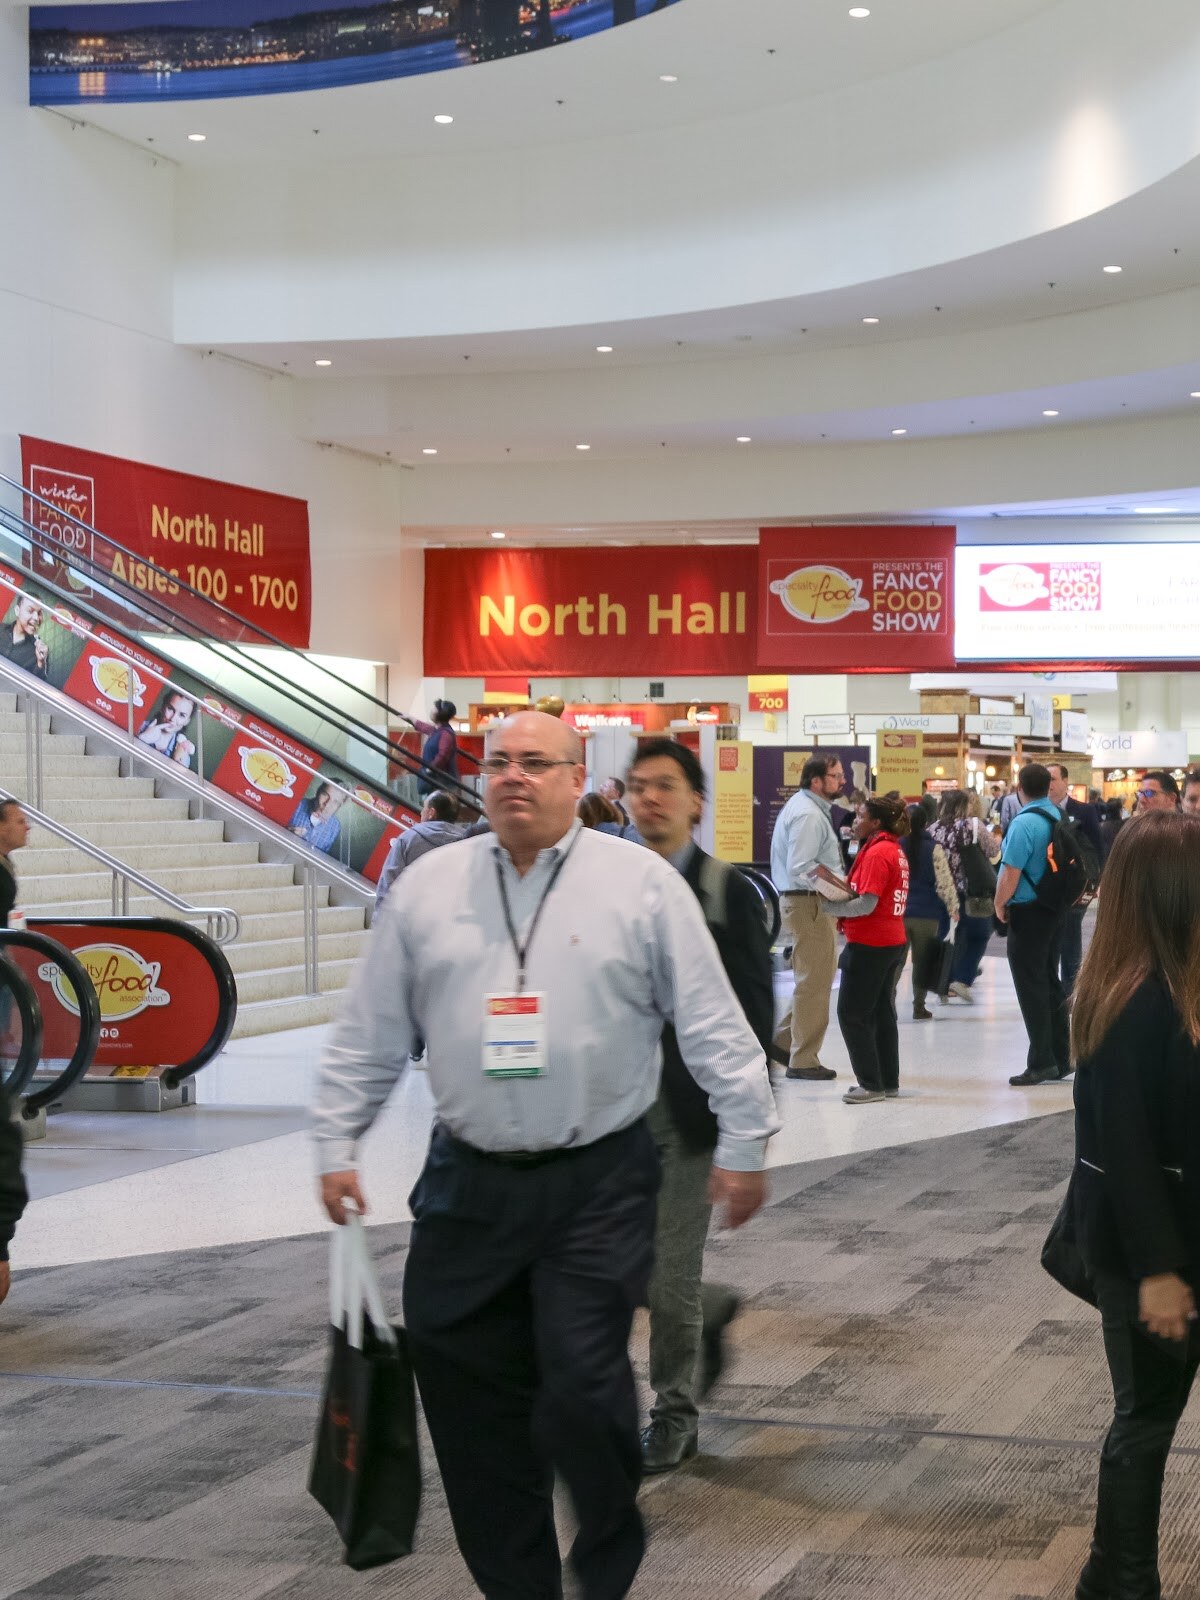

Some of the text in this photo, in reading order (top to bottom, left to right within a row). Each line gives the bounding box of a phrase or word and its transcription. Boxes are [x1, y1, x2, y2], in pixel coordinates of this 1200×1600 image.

[39, 483, 88, 503] winter
[39, 499, 87, 522] FANCY
[39, 521, 87, 548] FOOD
[152, 504, 264, 557] North Hall
[873, 562, 943, 571] PRESENTS THE
[1050, 568, 1100, 583] FANCY
[109, 552, 180, 595] Aisles
[187, 564, 228, 601] 100
[250, 574, 298, 611] 1700
[873, 572, 943, 590] FANCY
[1050, 582, 1100, 597] FOOD
[811, 574, 861, 619] food
[873, 591, 942, 612] FOOD
[1050, 597, 1099, 611] SHOW
[479, 591, 746, 637] North Hall
[873, 613, 940, 632] SHOW
[759, 697, 784, 709] 700
[574, 714, 632, 727] Walkers
[899, 717, 930, 727] World
[249, 722, 275, 740] BROUGHT
[275, 737, 284, 746] TO
[284, 743, 295, 754] YOU
[303, 754, 314, 764] THE
[1088, 735, 1132, 750] World
[94, 955, 157, 1001] food
